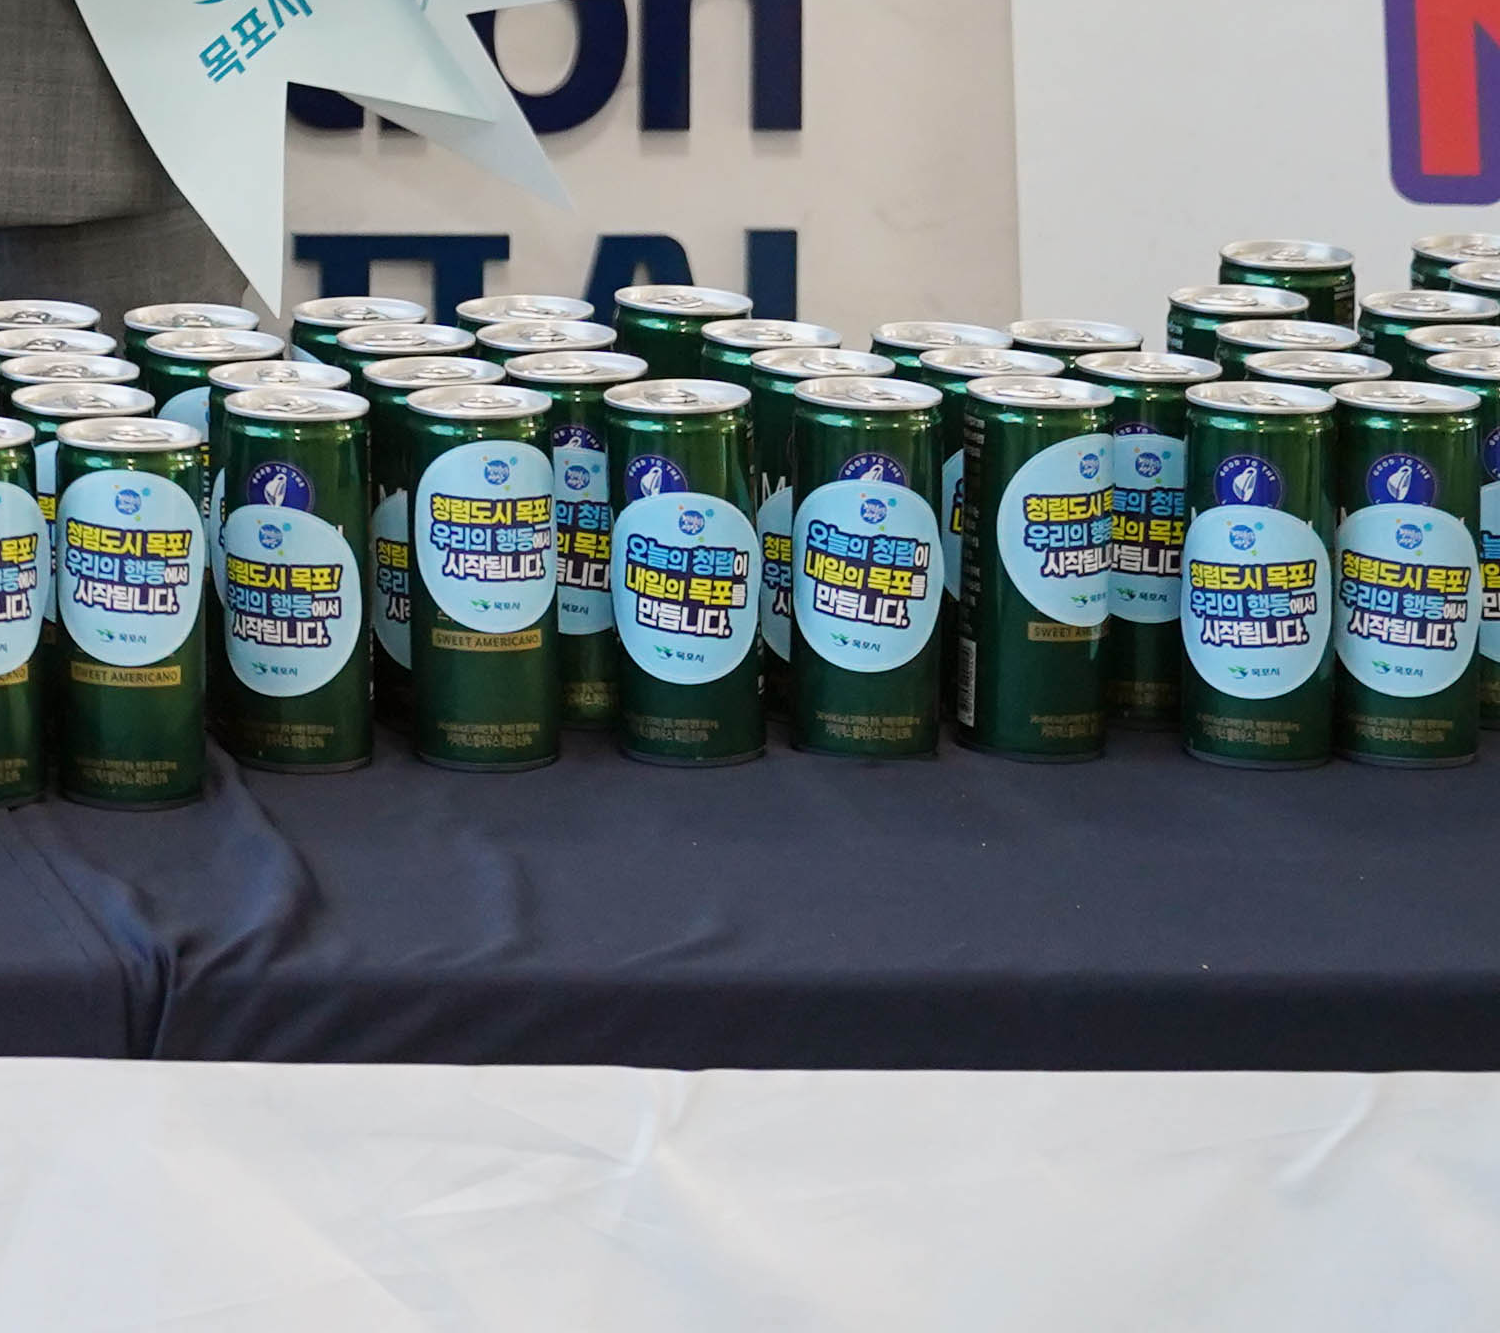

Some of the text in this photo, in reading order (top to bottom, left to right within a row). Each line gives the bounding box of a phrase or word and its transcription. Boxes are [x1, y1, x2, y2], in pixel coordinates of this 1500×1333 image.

[431, 493, 552, 524] 청렴도시 목포!
[1024, 494, 1102, 522] 청렴도시
[0, 533, 38, 565] 목포!
[66, 518, 192, 557] 청렴도시 목포!
[430, 524, 492, 553] 우리의
[807, 519, 930, 569] 오늘의 청렴이
[1024, 523, 1089, 552] 우리의
[65, 548, 189, 585] 우리의 행동에서
[226, 554, 343, 592] 청렴도시 목포!
[443, 552, 545, 581] 시작됩니다.
[627, 533, 749, 578] 오늘의 청렴이
[1342, 550, 1470, 594] 청렴도시 목포!
[625, 563, 747, 609] 내일의 목포를
[804, 548, 927, 600] 내일의 목포를
[1190, 559, 1316, 591] 청렴도시 목포!
[75, 579, 180, 614] 시작됩니다.
[227, 586, 342, 618] 우리의 행동에서
[814, 583, 911, 628] 만듭니다.
[1191, 590, 1316, 617] 우리의 행동에서
[1339, 582, 1466, 620] 우리의 행동에서
[232, 616, 331, 647] 시작됩니다.
[637, 595, 732, 638] 만듭니다.
[1202, 618, 1309, 647] 시작됩니다.
[1349, 611, 1457, 650] 시작됩니다.
[110, 670, 178, 683] AMERICANO
